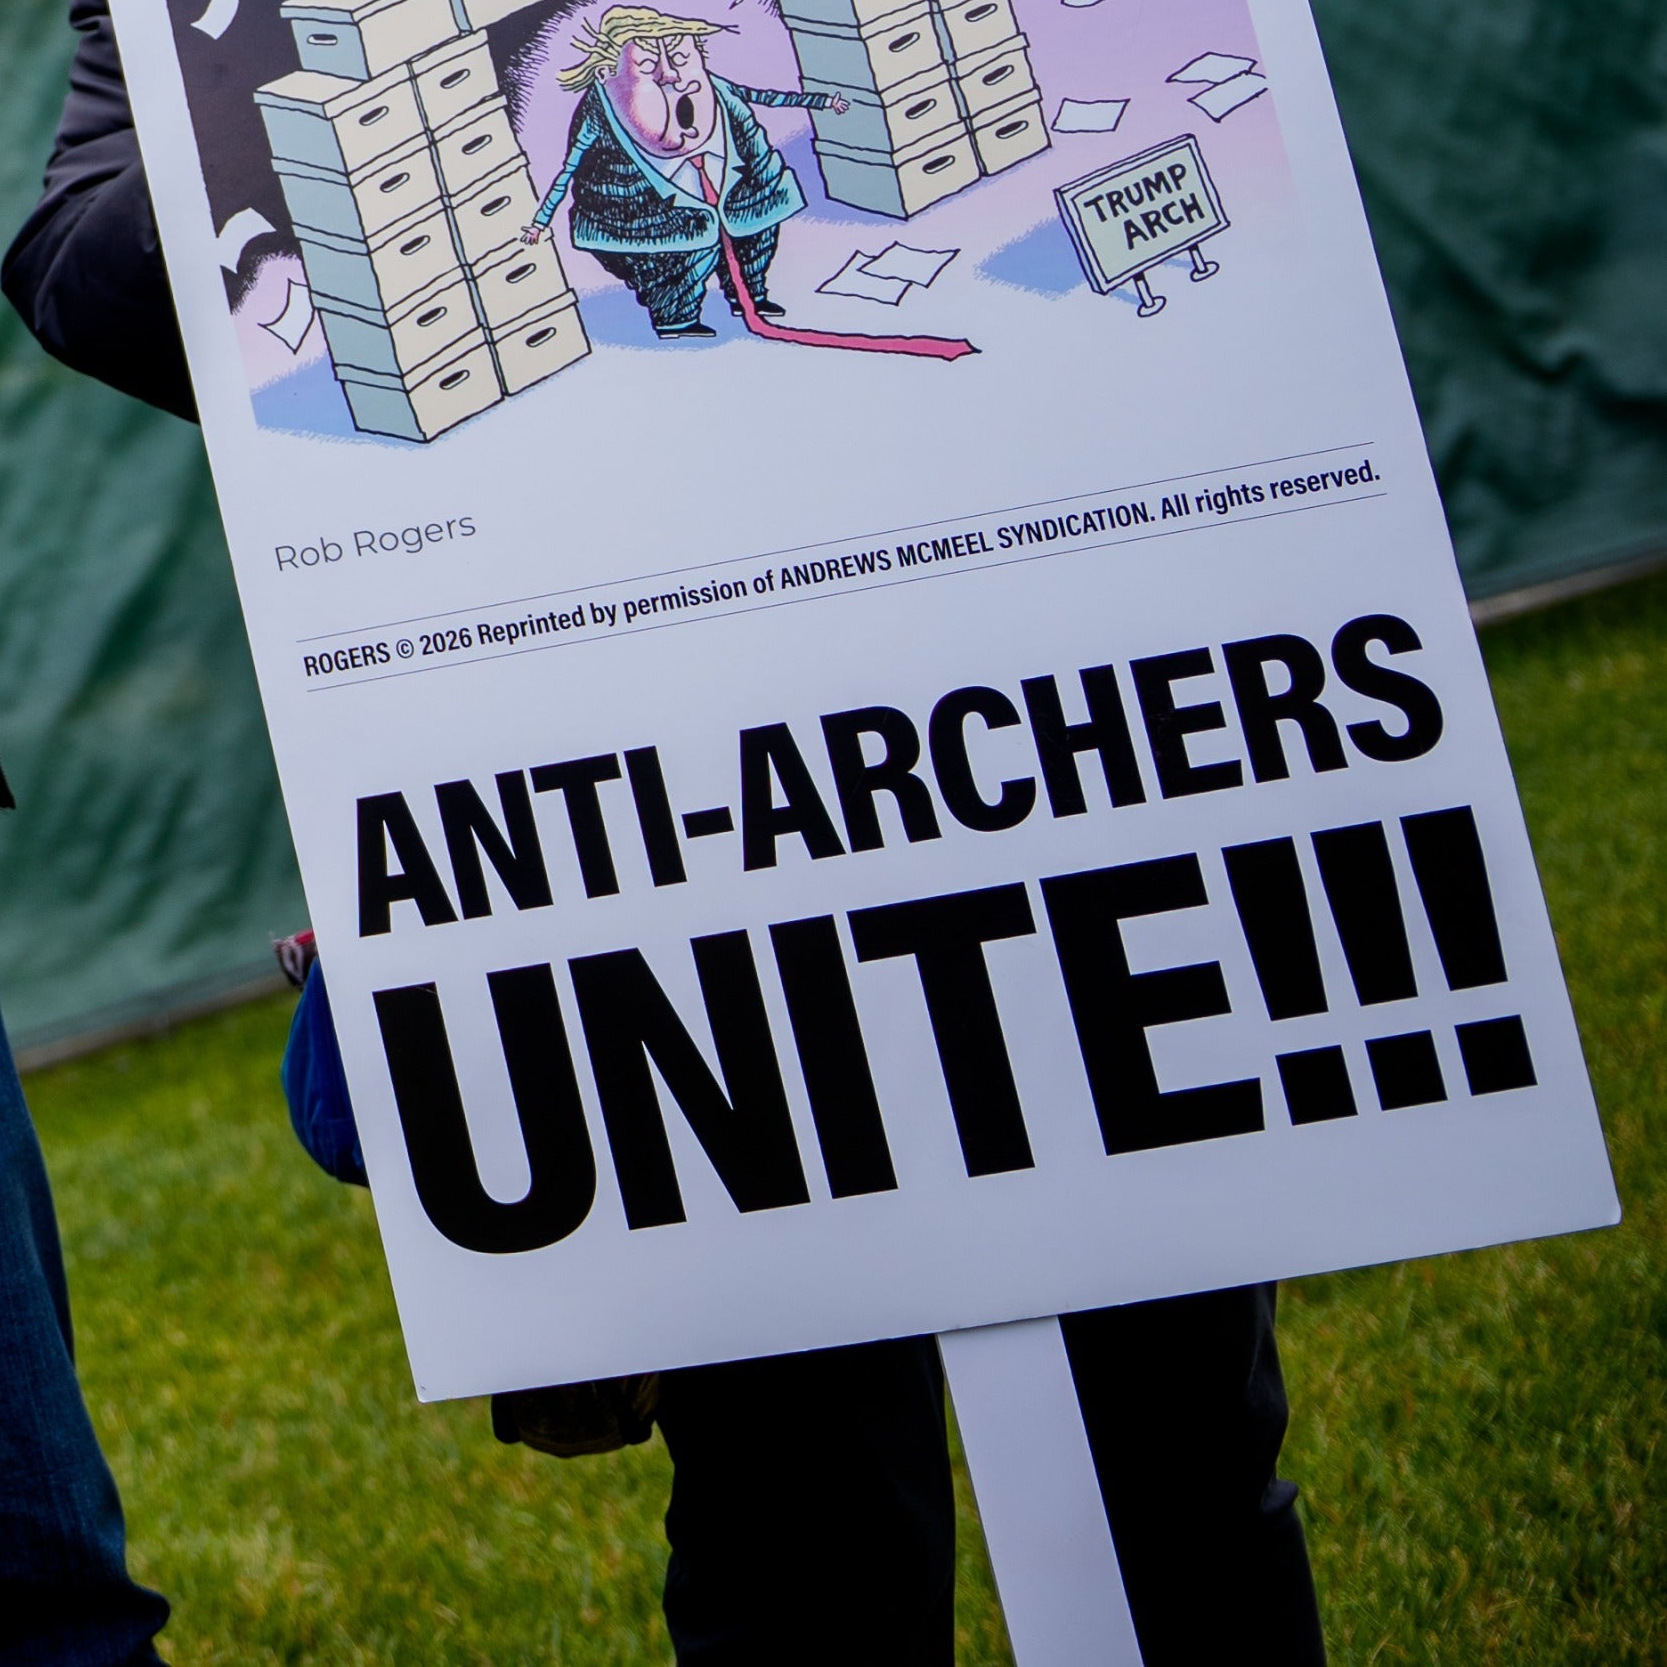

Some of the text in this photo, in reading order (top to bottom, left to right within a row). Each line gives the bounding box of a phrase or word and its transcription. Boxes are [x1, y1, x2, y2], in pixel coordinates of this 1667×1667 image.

[1083, 163, 1187, 223] TRUMP
[1123, 192, 1205, 250] ARCH
[274, 516, 477, 572] Rob Rogers
[303, 642, 392, 677] ROGERS
[419, 628, 473, 657] 2026
[478, 604, 586, 646] Reprinted
[591, 601, 618, 626] by
[622, 579, 748, 624] permission
[752, 569, 777, 594] of
[780, 549, 892, 591] ANDREWS
[896, 530, 994, 570] MCMEEL
[997, 502, 1156, 550] SYNDICATION.
[1161, 493, 1191, 521] All
[1194, 484, 1266, 519] rights
[1269, 459, 1381, 501] reserved.
[354, 613, 1445, 938] ANTI-ARCHERS
[371, 804, 1538, 1256] UNITE!!!
